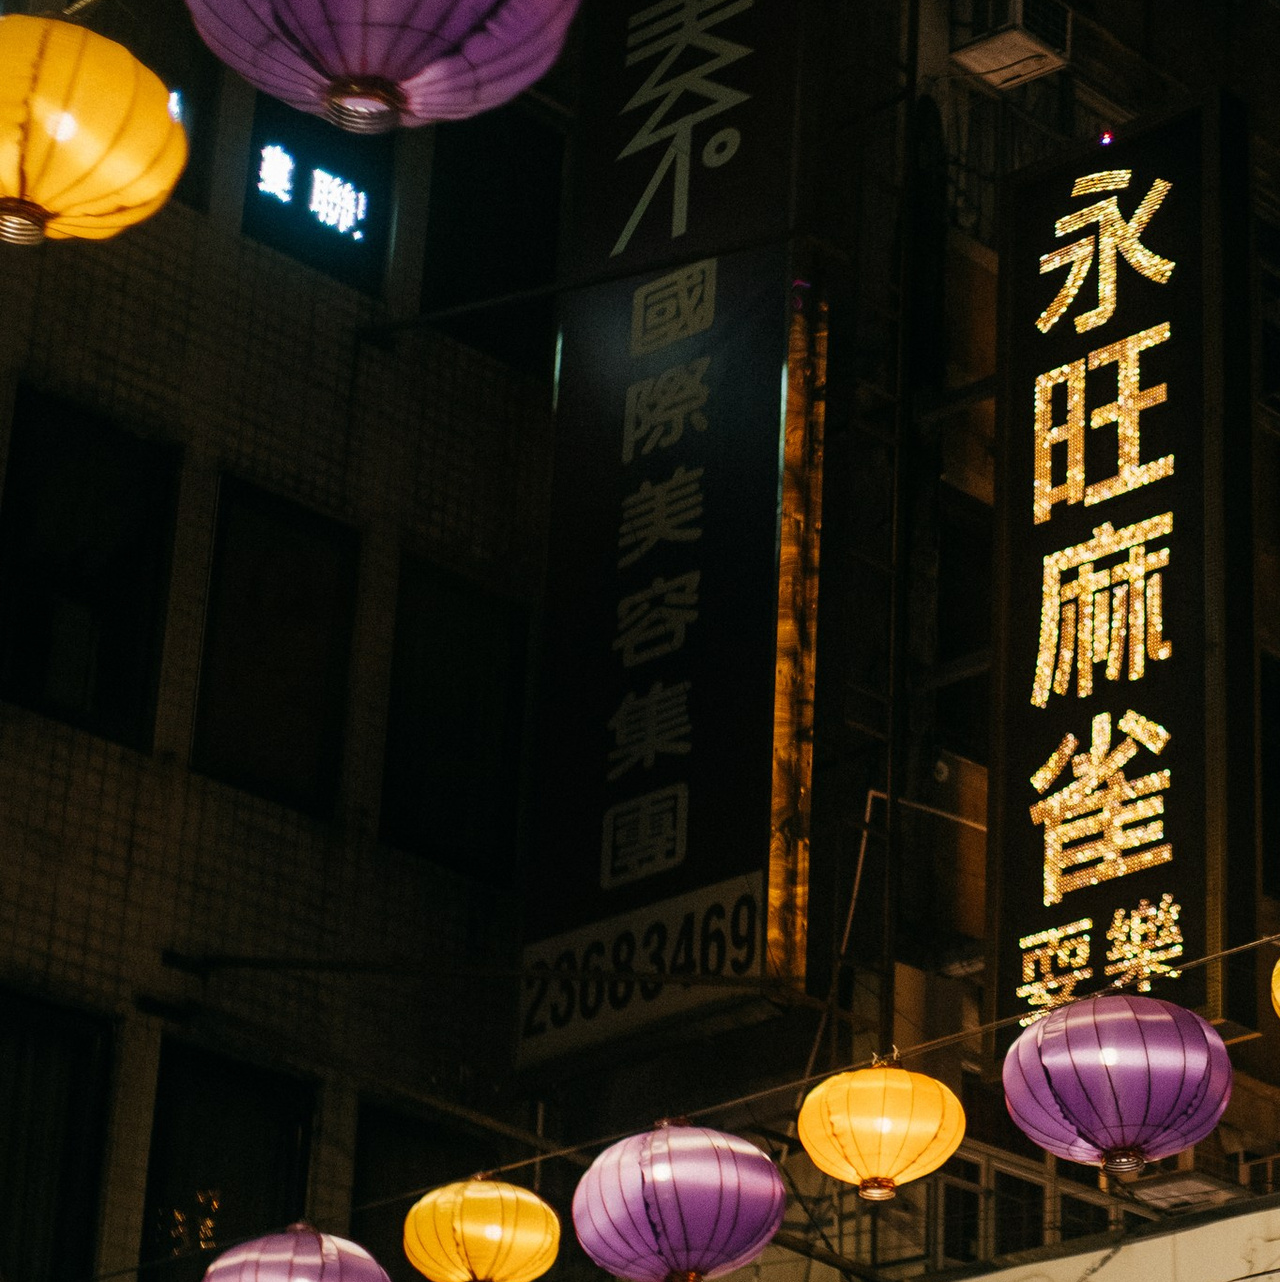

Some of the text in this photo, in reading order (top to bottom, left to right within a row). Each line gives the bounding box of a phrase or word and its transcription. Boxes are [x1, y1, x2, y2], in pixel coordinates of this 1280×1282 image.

[600, 257, 719, 891] 國際美容集團
[1031, 169, 1176, 908] 永旺麻雀
[522, 893, 758, 1039] 23683469
